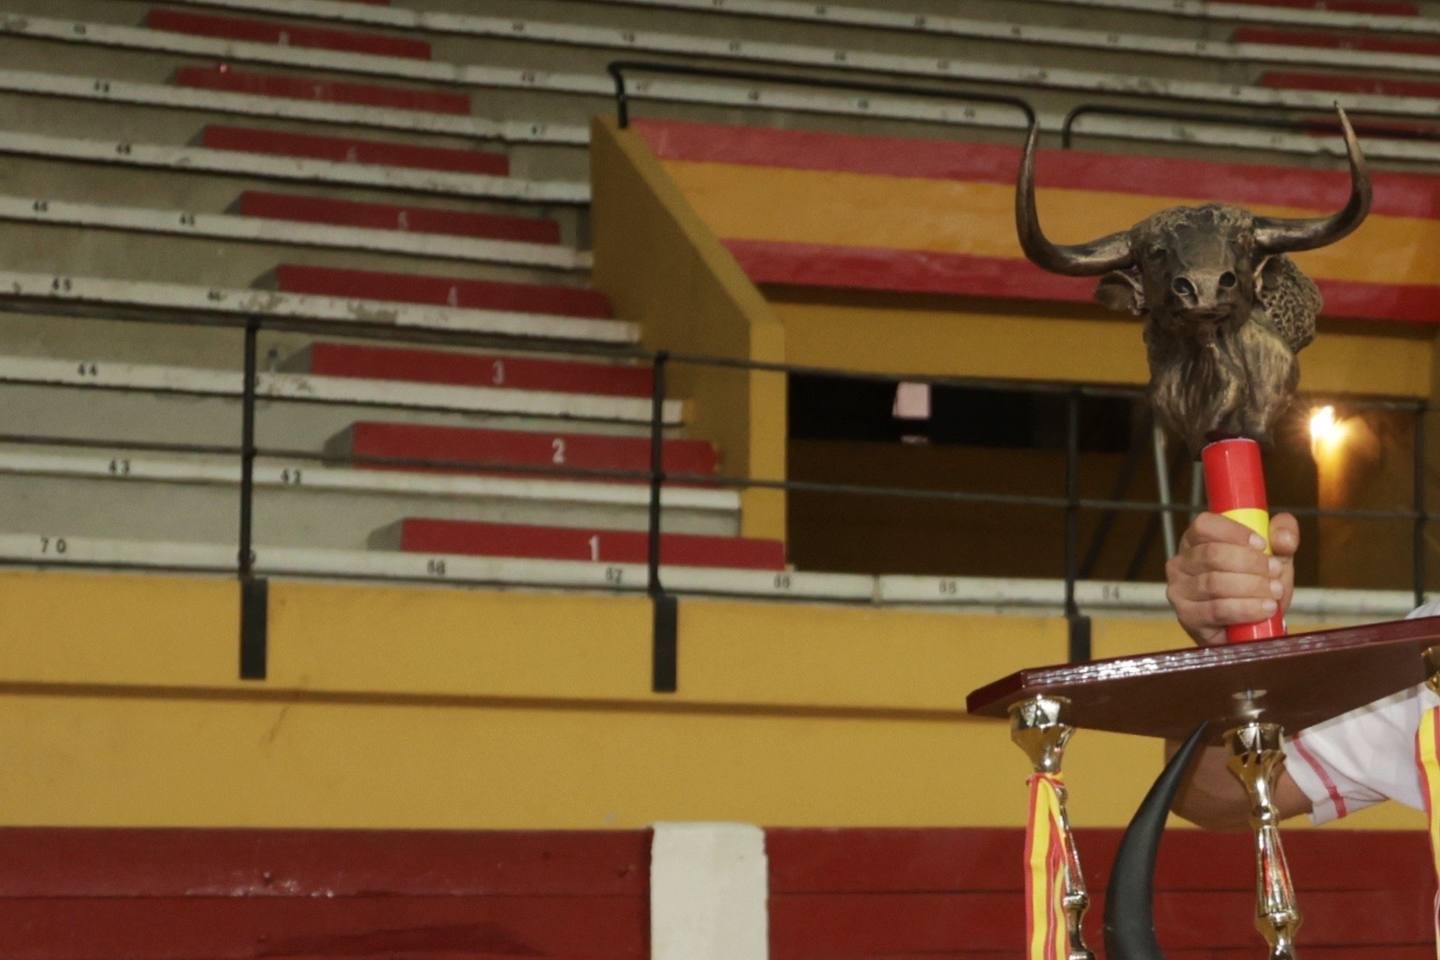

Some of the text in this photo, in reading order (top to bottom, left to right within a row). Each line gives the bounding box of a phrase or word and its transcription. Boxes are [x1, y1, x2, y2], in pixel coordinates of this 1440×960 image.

[493, 361, 505, 385] 3
[552, 438, 566, 464] 2
[41, 537, 67, 554] 70
[588, 535, 599, 562] 1
